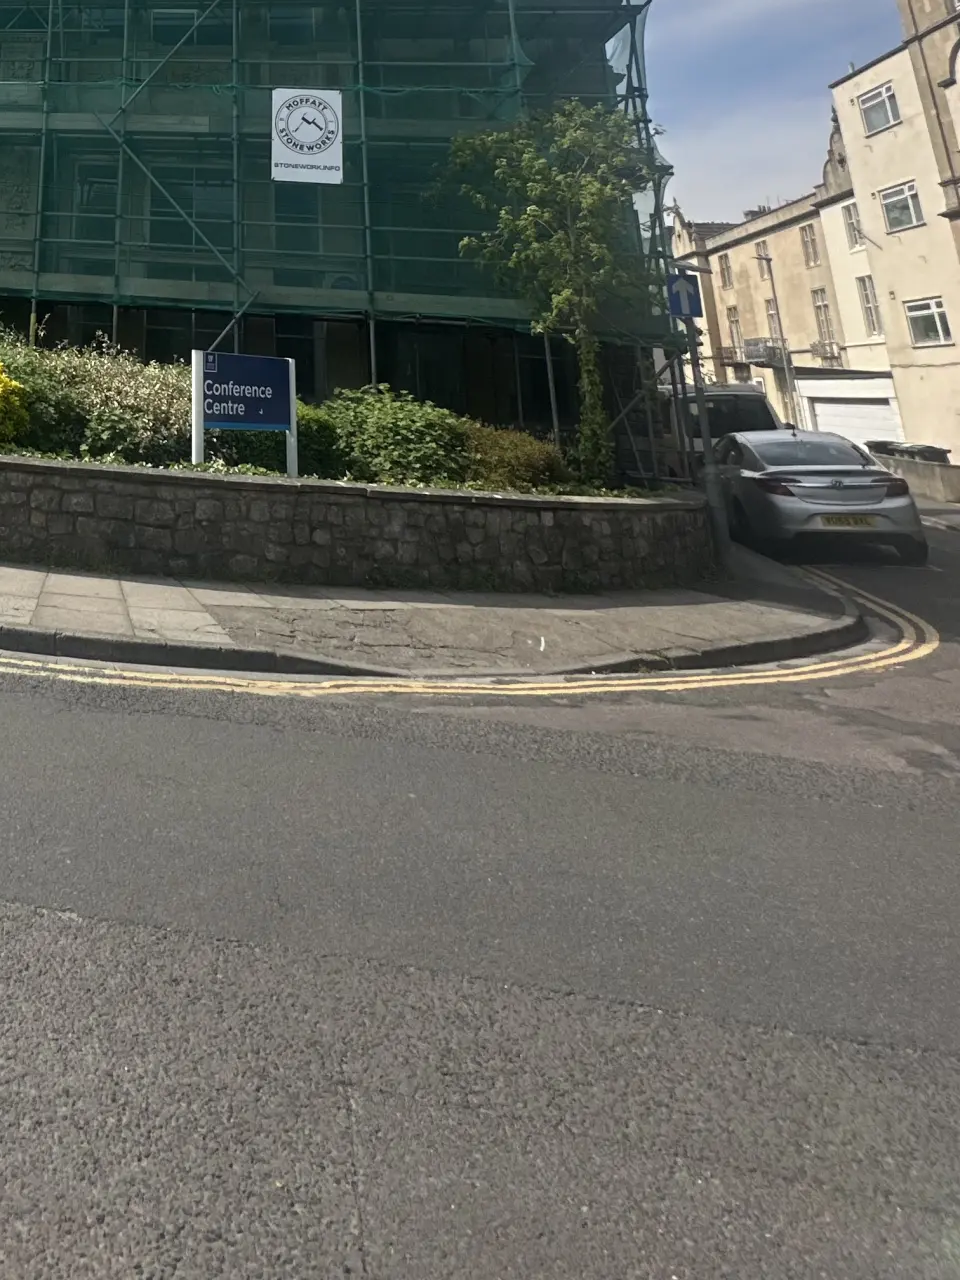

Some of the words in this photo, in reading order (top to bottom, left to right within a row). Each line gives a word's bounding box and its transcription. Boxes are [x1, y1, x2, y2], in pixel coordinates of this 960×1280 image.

[286, 98, 328, 111] MOFFATT
[279, 128, 335, 152] STONEWORKS
[274, 162, 341, 172] STONEWORK.INFO
[204, 380, 273, 398] Conference
[204, 398, 246, 415] Centre
